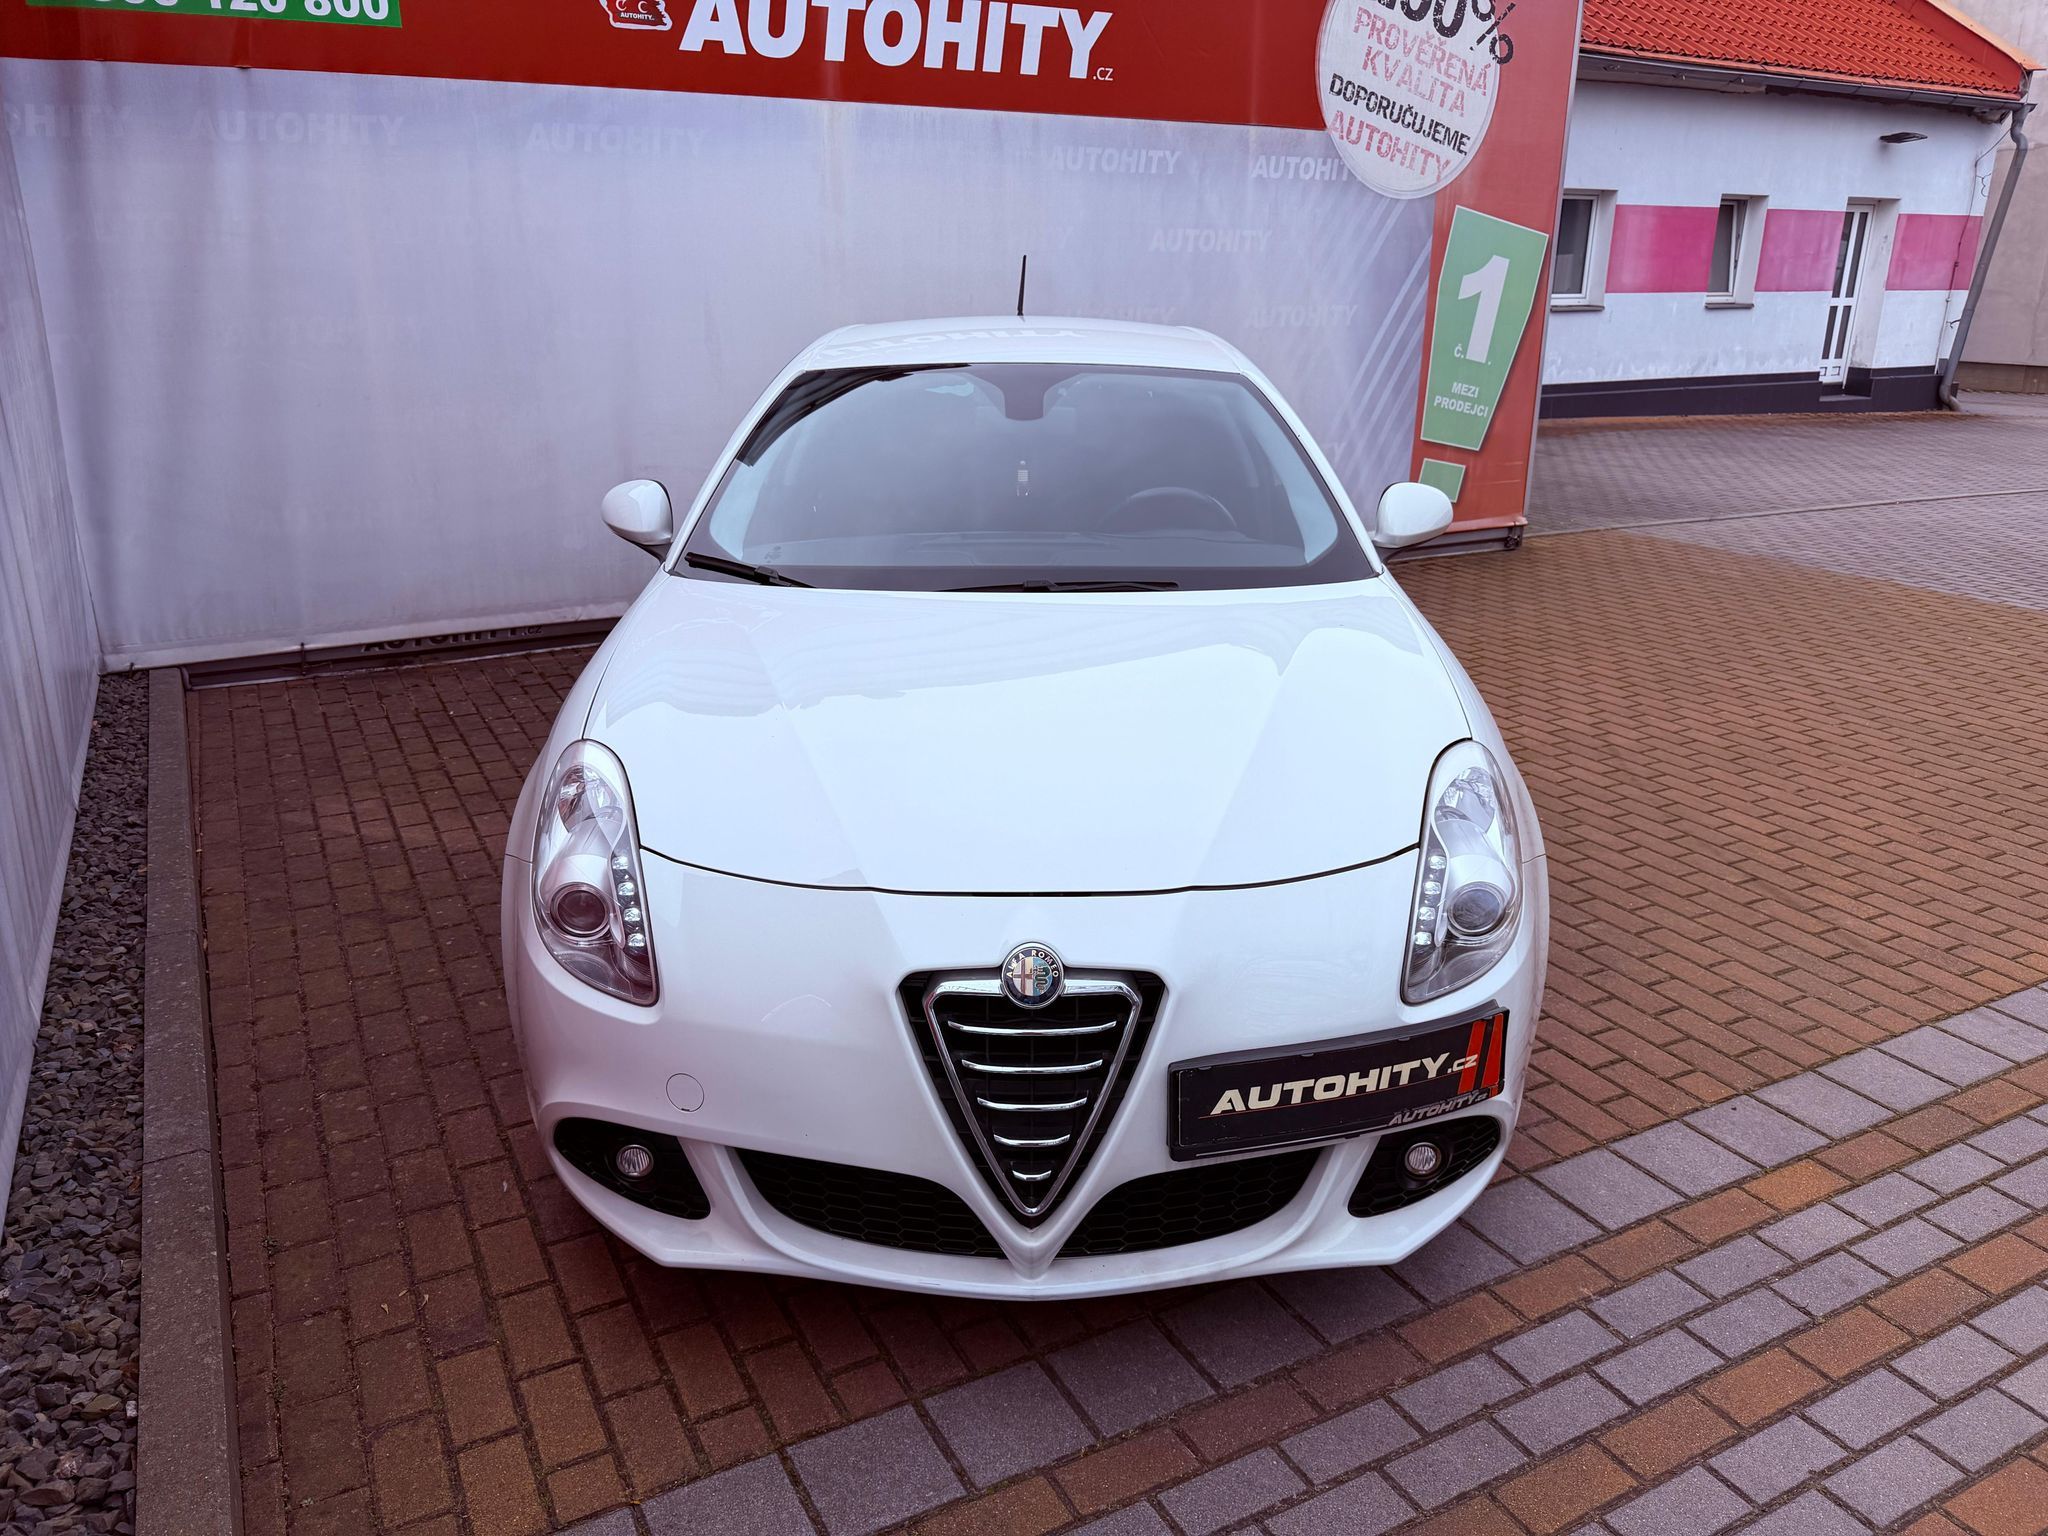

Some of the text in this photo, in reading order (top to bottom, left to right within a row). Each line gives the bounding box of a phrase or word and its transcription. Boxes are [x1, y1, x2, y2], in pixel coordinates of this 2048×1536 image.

[1353, 7, 1491, 96] PROVĚŘENÁ
[1377, 0, 1516, 64] 0%
[1362, 46, 1465, 117] KVALITA
[1329, 73, 1471, 155] DOPORUČUJEME
[1050, 146, 1181, 174] AUTOHITY
[1328, 110, 1451, 183] AUTOHITY
[1150, 228, 1272, 253] AUTOHITY
[1434, 395, 1489, 418] PRODEJCI
[1451, 381, 1480, 398] MEZI
[1031, 949, 1059, 978] ROMEO
